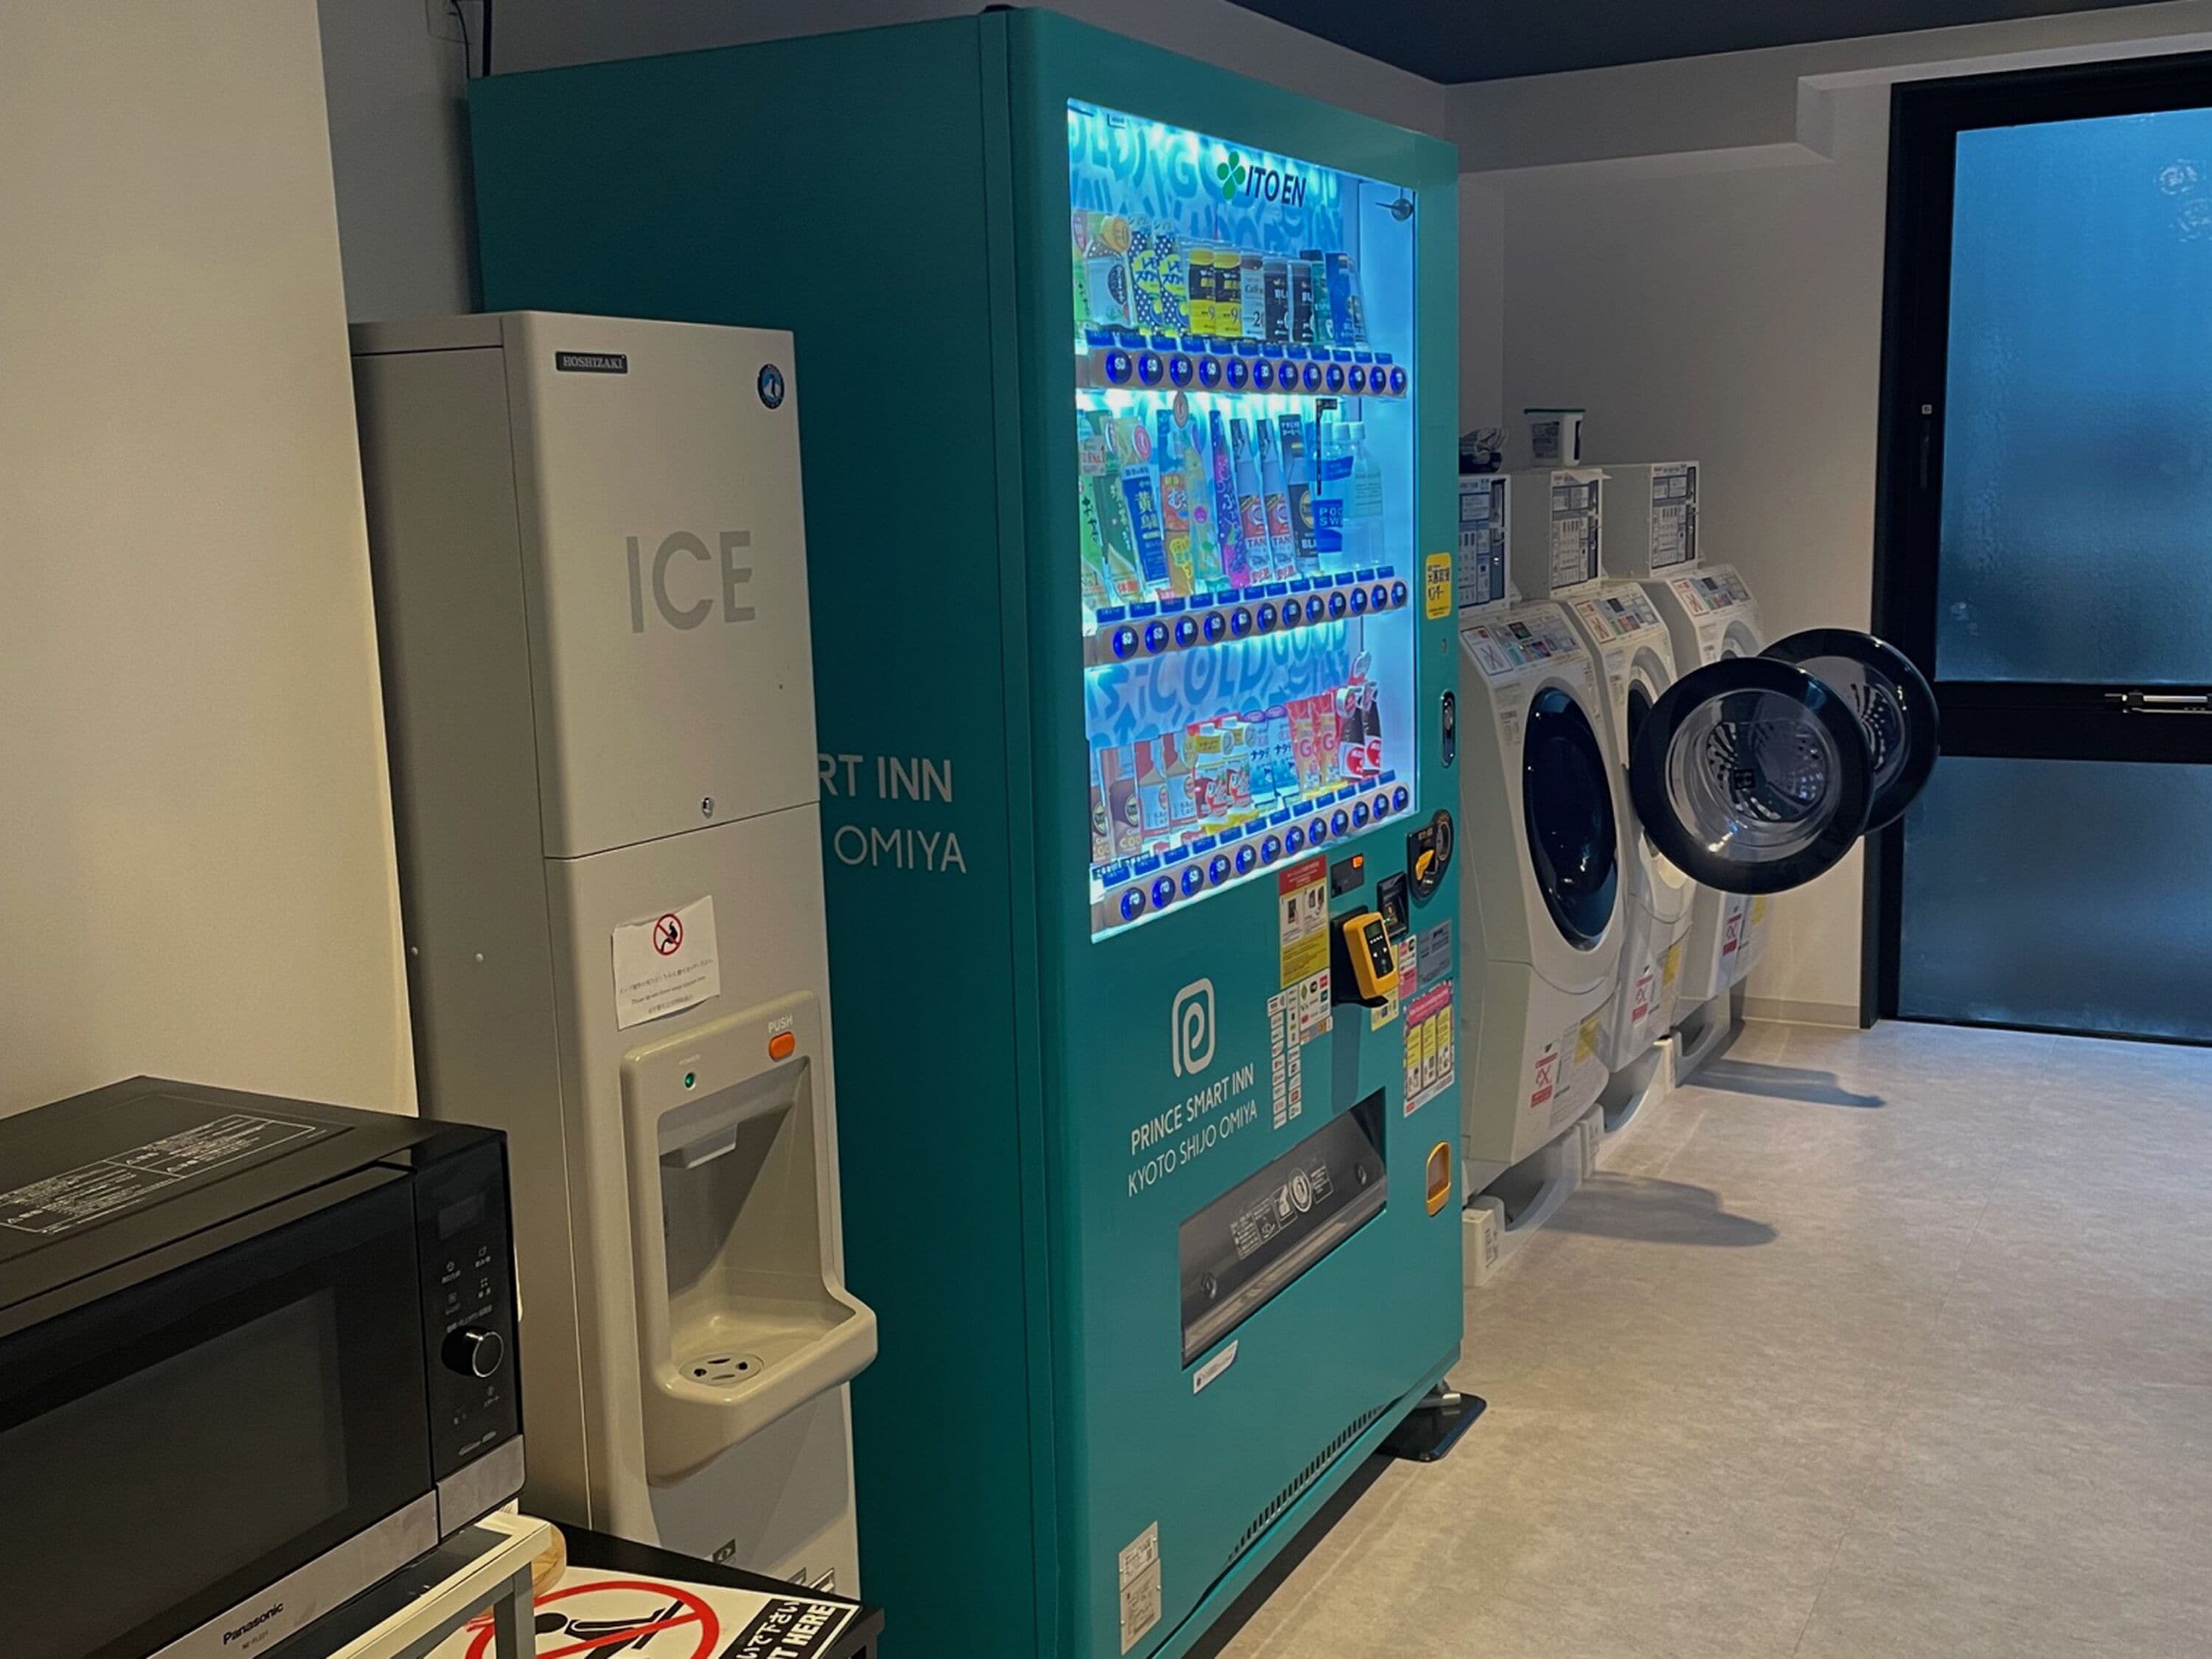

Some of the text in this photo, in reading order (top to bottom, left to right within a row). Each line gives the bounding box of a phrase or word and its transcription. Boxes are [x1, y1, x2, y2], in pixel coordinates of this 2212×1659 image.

[1245, 164, 1307, 208] ITO EN
[563, 355, 624, 369] HOSHIZAKI
[625, 529, 757, 634] ICE
[877, 756, 953, 803] INN
[833, 824, 967, 874] OMIYA
[767, 1014, 793, 1034] PUSH
[1130, 1062, 1254, 1156] PRINCE SMART INN
[1127, 1099, 1258, 1198] KYOTO SHIJO OMIYA
[223, 1602, 285, 1646] Panasonic
[782, 1604, 836, 1646] HERE
